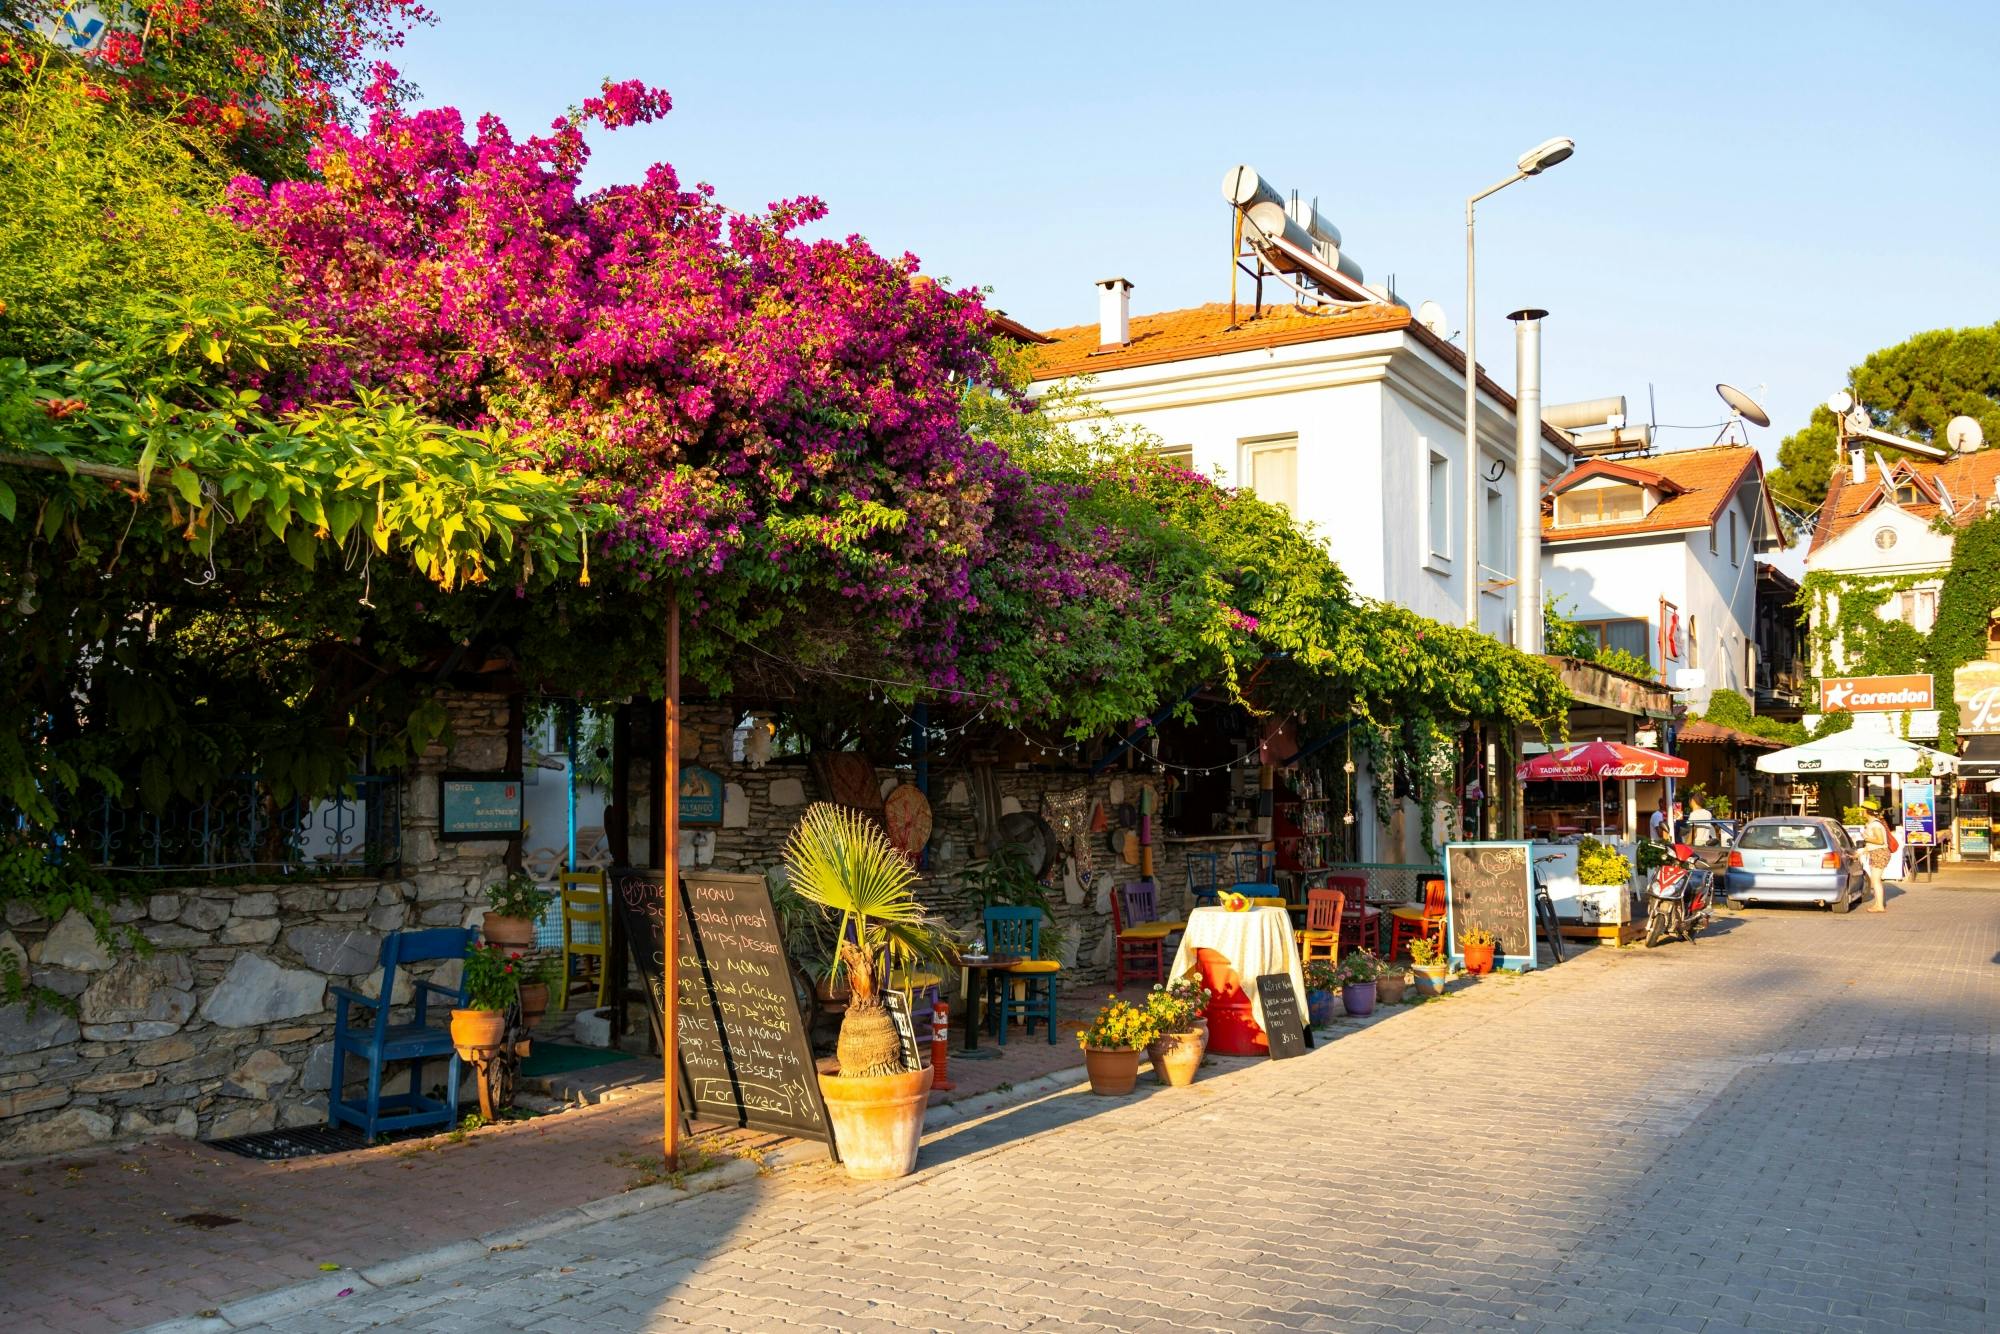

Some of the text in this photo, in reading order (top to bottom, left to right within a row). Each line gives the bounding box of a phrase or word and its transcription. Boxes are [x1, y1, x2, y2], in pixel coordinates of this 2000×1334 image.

[1850, 688, 1928, 705] corendon
[449, 783, 475, 792] HOTEL
[702, 1080, 734, 1101] For
